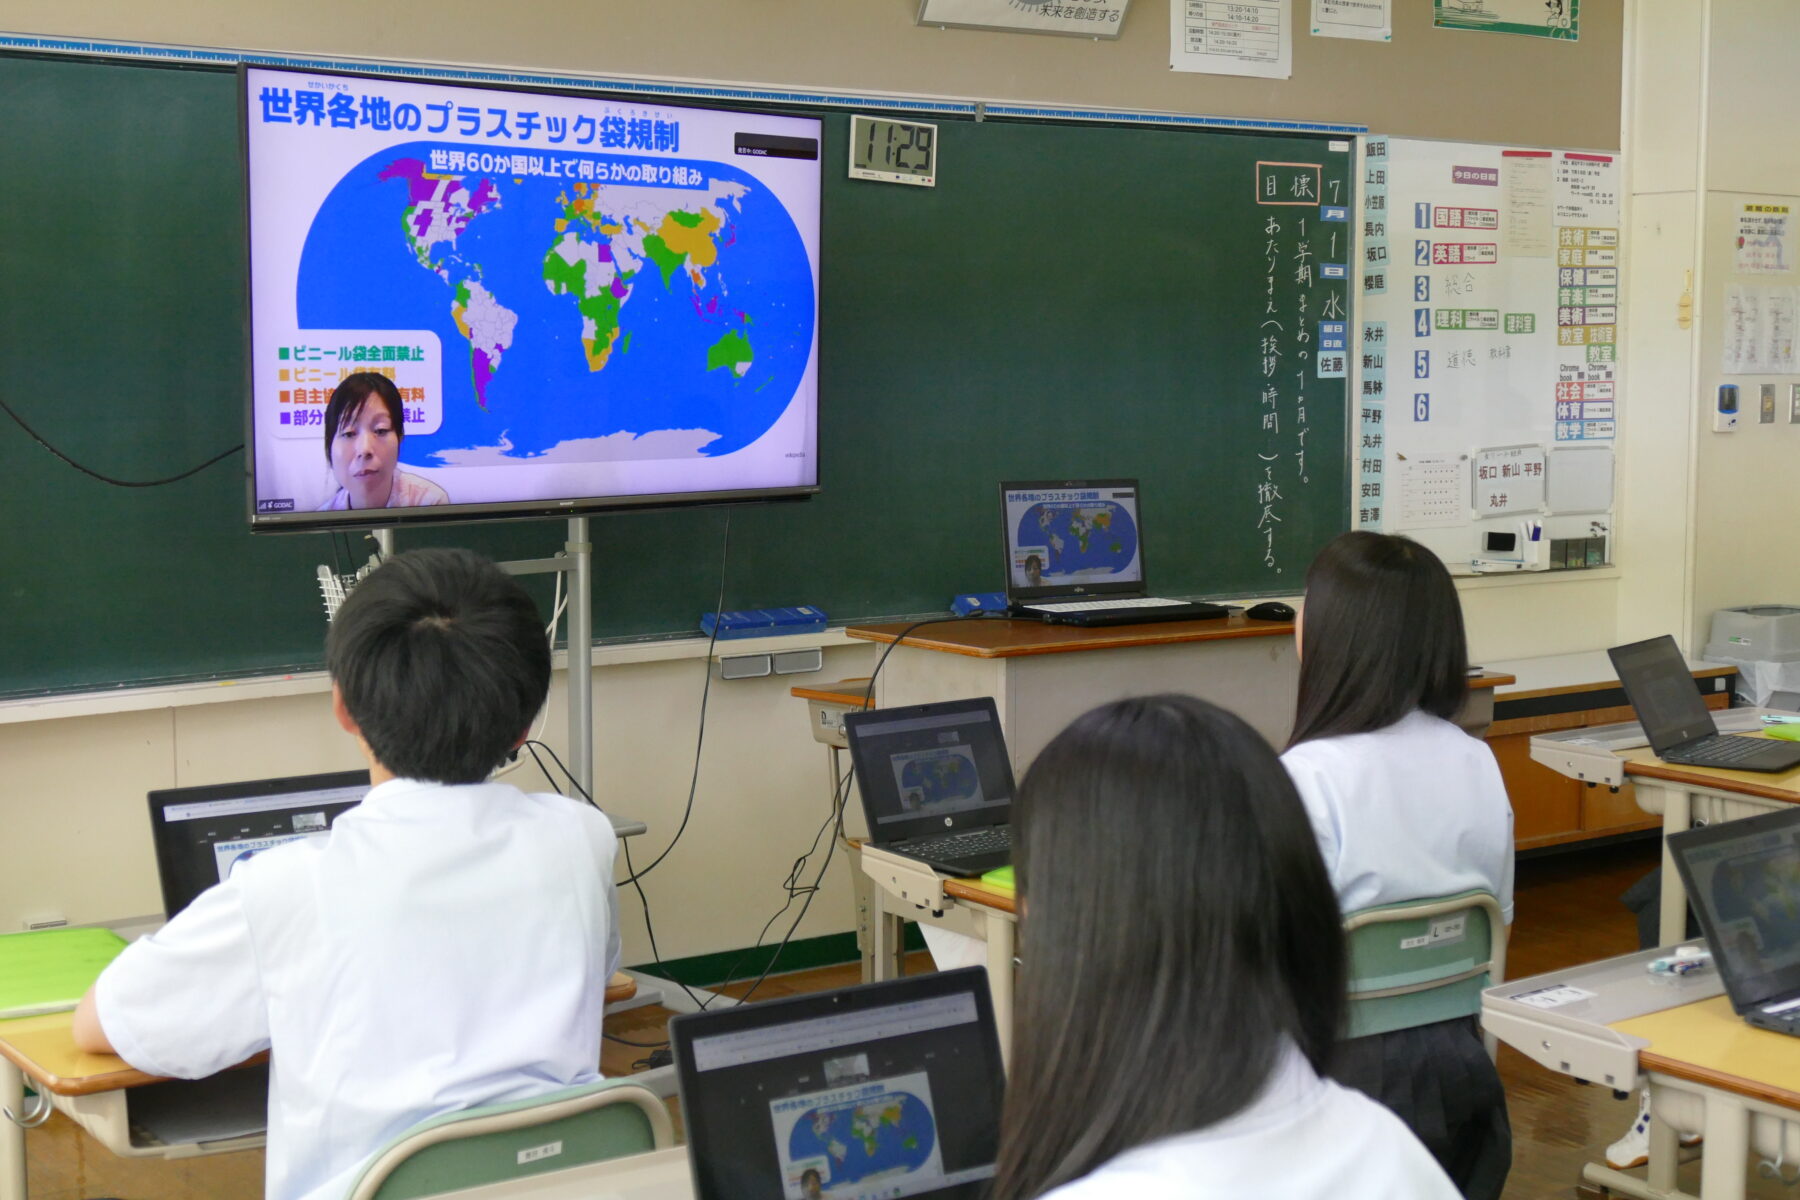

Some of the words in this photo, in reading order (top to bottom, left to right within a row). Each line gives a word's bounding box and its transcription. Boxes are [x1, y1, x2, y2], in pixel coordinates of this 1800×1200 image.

[1041, 5, 1120, 22] 未来を創造する
[259, 86, 680, 152] 世界各地のプラスチック袋規制
[867, 121, 932, 171] 11:29
[1366, 142, 1386, 157] 飯田
[430, 149, 703, 186] 世界60か国以上で何らかの取り組み
[1266, 174, 1315, 198] 目標
[1365, 170, 1385, 185] 上田
[1364, 195, 1385, 210] 小笠原
[1419, 203, 1427, 228] 1
[1364, 222, 1384, 236] 長内
[1367, 246, 1387, 262] 坂口
[1417, 240, 1428, 265] 2
[1434, 244, 1460, 263] 英語
[1417, 276, 1428, 301] 3
[1322, 290, 1345, 319] 水
[1417, 310, 1428, 336] 4
[1364, 328, 1384, 342] 永井
[294, 345, 425, 362] ビニール袋全面禁止
[1363, 354, 1383, 369] 新山
[1320, 356, 1344, 373] 佐藤
[1416, 352, 1427, 378] 5
[1557, 383, 1581, 400] 社会
[1416, 394, 1427, 420] 6
[1557, 401, 1581, 419] 体育
[1362, 408, 1382, 424] 平野
[1362, 434, 1382, 448] 丸井
[1362, 459, 1382, 473] 村田
[1479, 466, 1497, 479] 坂口
[1503, 463, 1520, 478] 新山
[1524, 462, 1542, 476] 平野
[1361, 483, 1381, 497] 安田
[1490, 493, 1508, 507] 丸井
[1360, 507, 1380, 522] 吉澤
